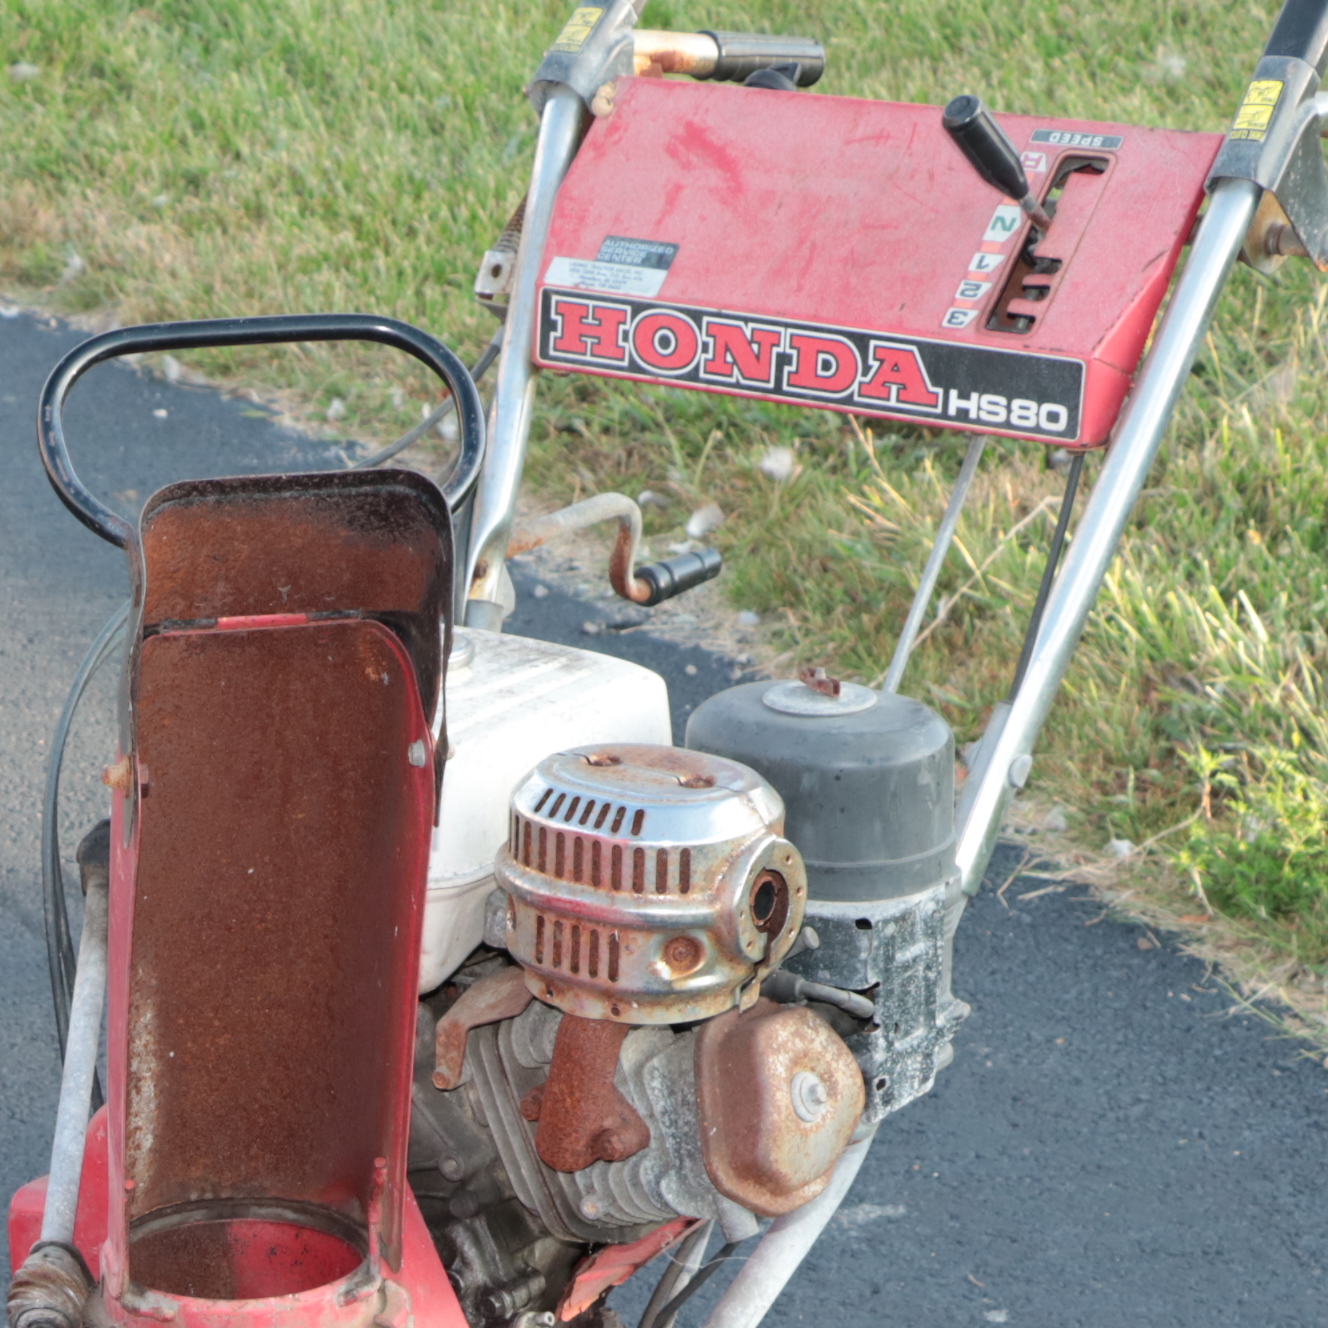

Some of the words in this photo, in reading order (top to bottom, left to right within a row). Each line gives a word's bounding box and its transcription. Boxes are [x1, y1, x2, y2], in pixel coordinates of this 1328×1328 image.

[1048, 132, 1104, 147] SPEED
[990, 215, 1017, 232] N
[600, 246, 648, 258] SERVICE
[603, 239, 675, 254] AUTHORIZED
[597, 252, 643, 264] CENTER
[975, 255, 990, 270] 1
[958, 281, 983, 298] 2
[946, 310, 969, 326] 3
[549, 296, 943, 412] HONDA
[947, 390, 1069, 434] HS80
